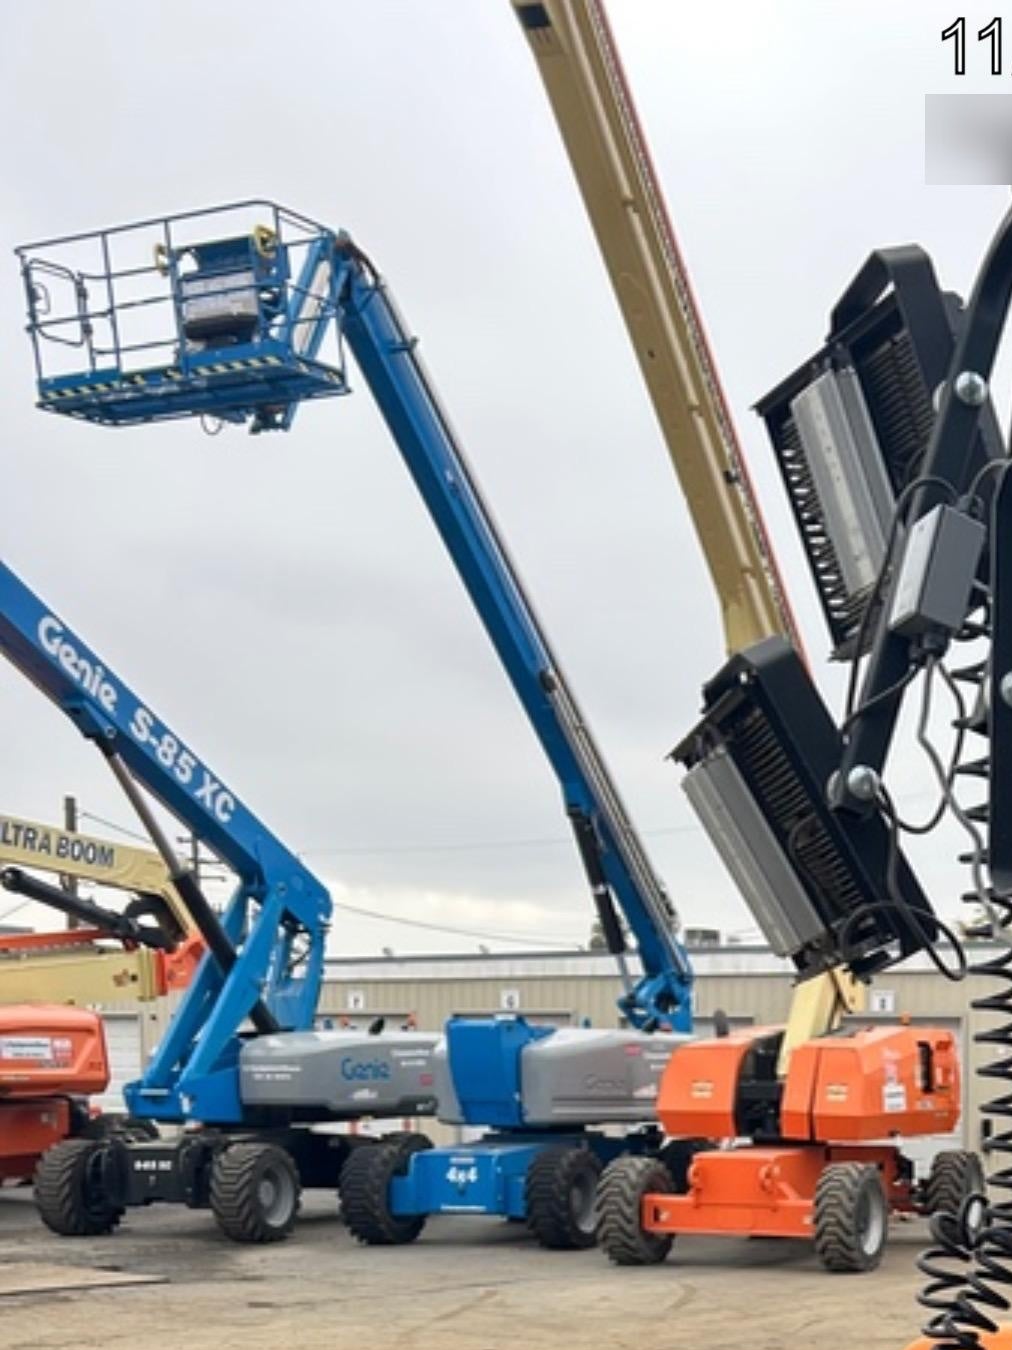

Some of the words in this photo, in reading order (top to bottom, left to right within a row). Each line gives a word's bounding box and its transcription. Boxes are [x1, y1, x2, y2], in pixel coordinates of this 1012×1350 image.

[37, 614, 118, 717] Genie
[129, 706, 198, 784] S-85
[193, 772, 236, 823] XC
[56, 835, 115, 868] BOOM
[341, 1057, 392, 1081] Genie
